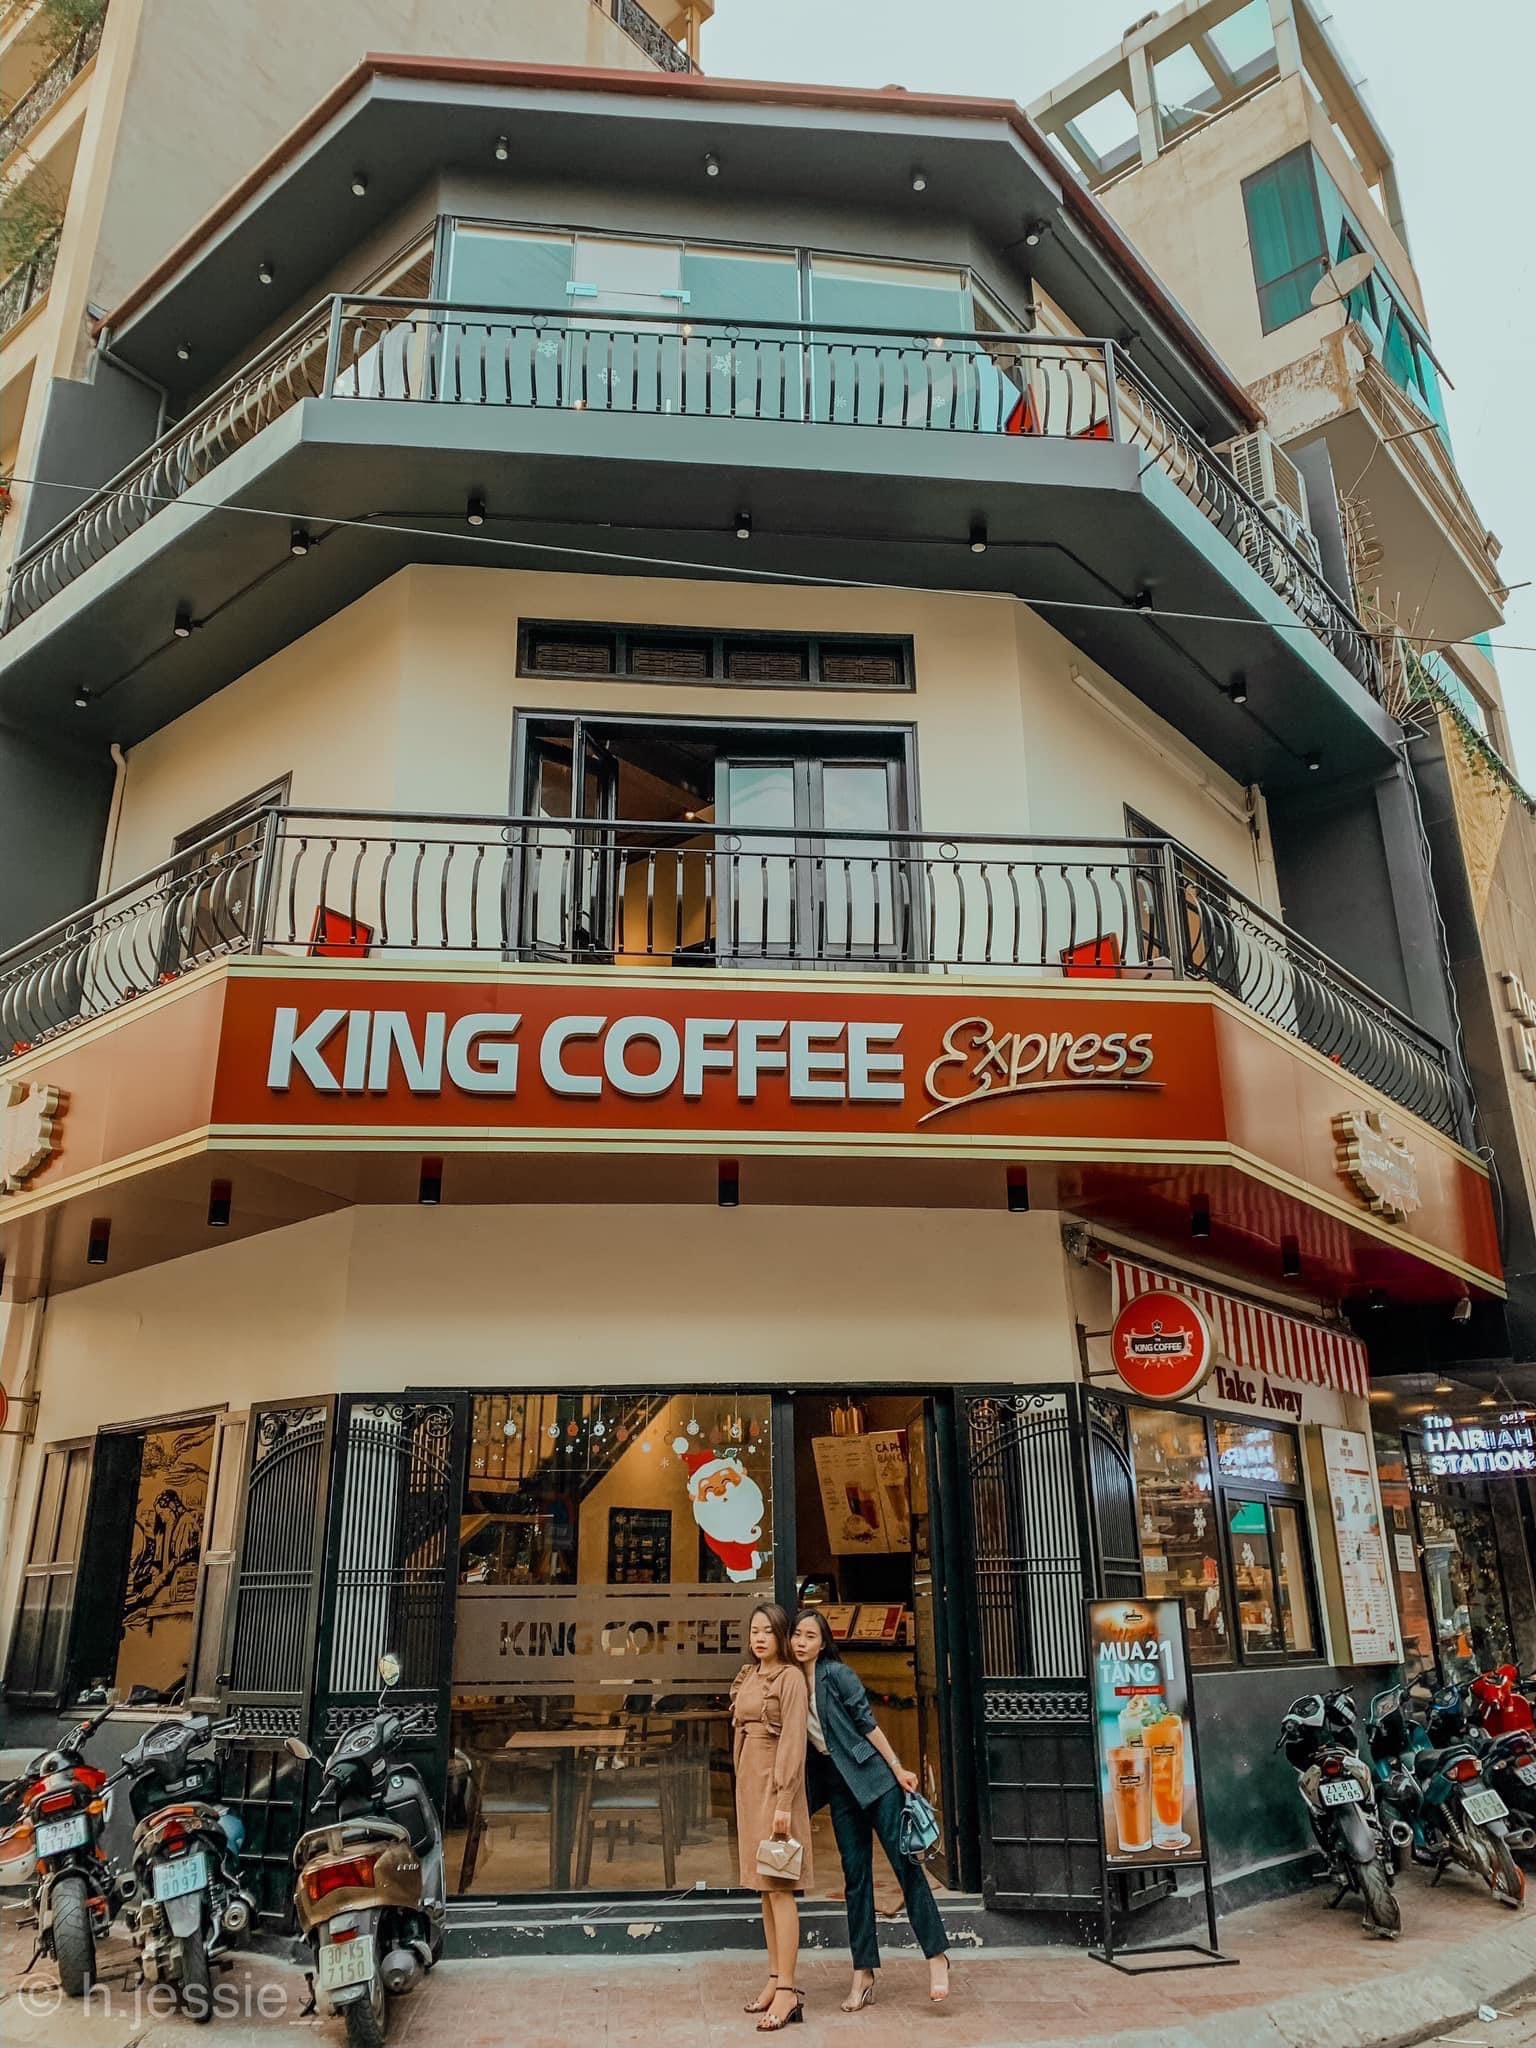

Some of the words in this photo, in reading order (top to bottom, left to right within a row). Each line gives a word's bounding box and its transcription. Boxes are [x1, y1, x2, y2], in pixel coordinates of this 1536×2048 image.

[267, 1007, 522, 1095] KING
[539, 1015, 905, 1103] COFFEE
[922, 1015, 1160, 1114] Express
[1134, 1343, 1154, 1352] KING
[1153, 1342, 1183, 1351] COFFEE
[1212, 1366, 1257, 1405] Take
[1262, 1376, 1303, 1422] Away
[1425, 1427, 1486, 1453] HAIR
[1429, 1450, 1532, 1476] STATION
[500, 1620, 594, 1657] KING
[600, 1620, 742, 1657] COFFEE
[1159, 1639, 1175, 1681] 1
[162, 1873, 198, 1898] 8097
[327, 1960, 366, 1984] 7150
